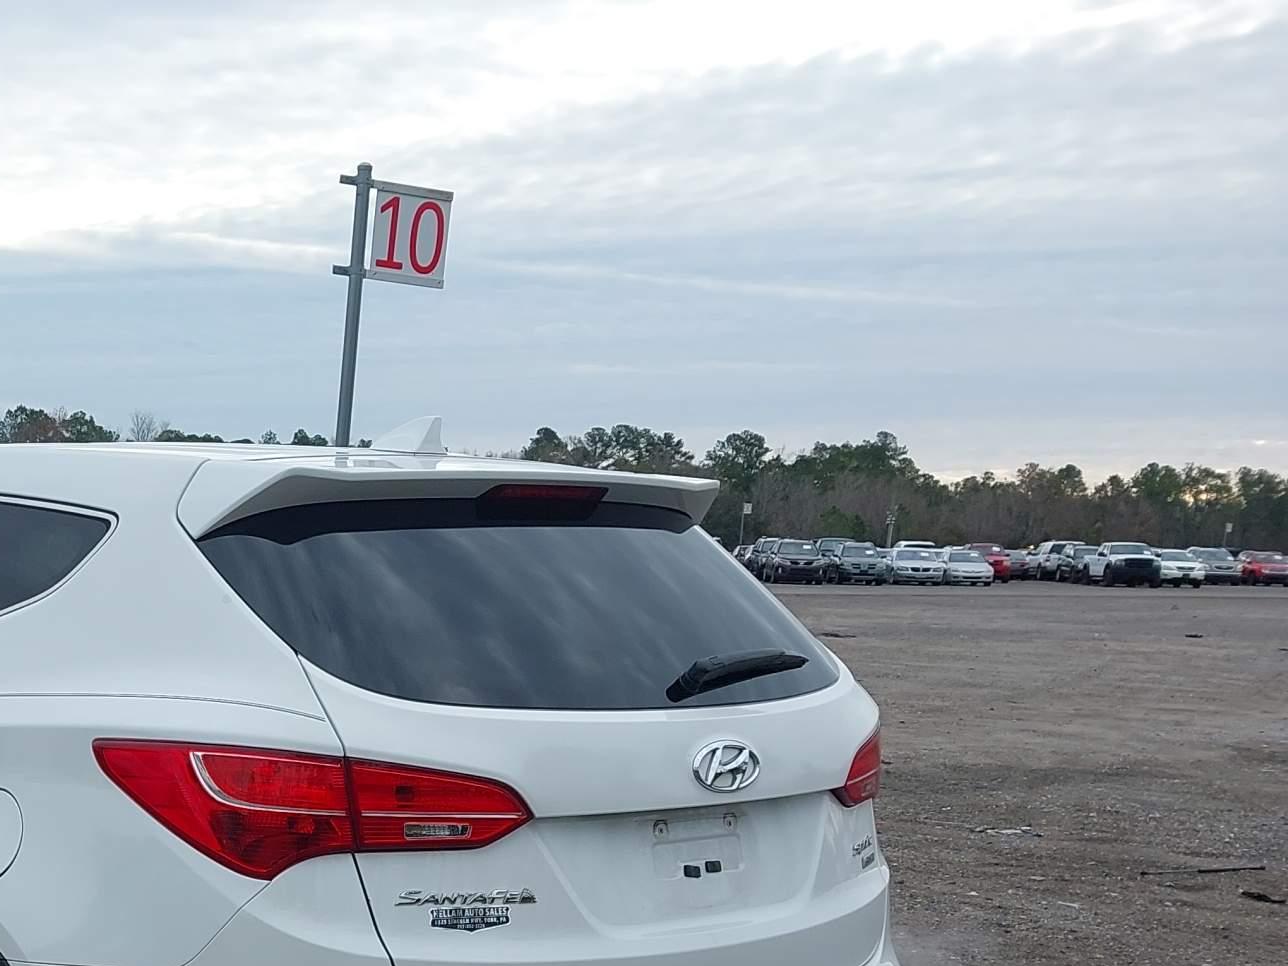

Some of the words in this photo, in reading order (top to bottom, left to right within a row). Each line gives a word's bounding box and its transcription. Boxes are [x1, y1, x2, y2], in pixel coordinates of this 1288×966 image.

[375, 195, 446, 275] 10
[464, 908, 484, 917] AUTO
[485, 907, 508, 916] SALES
